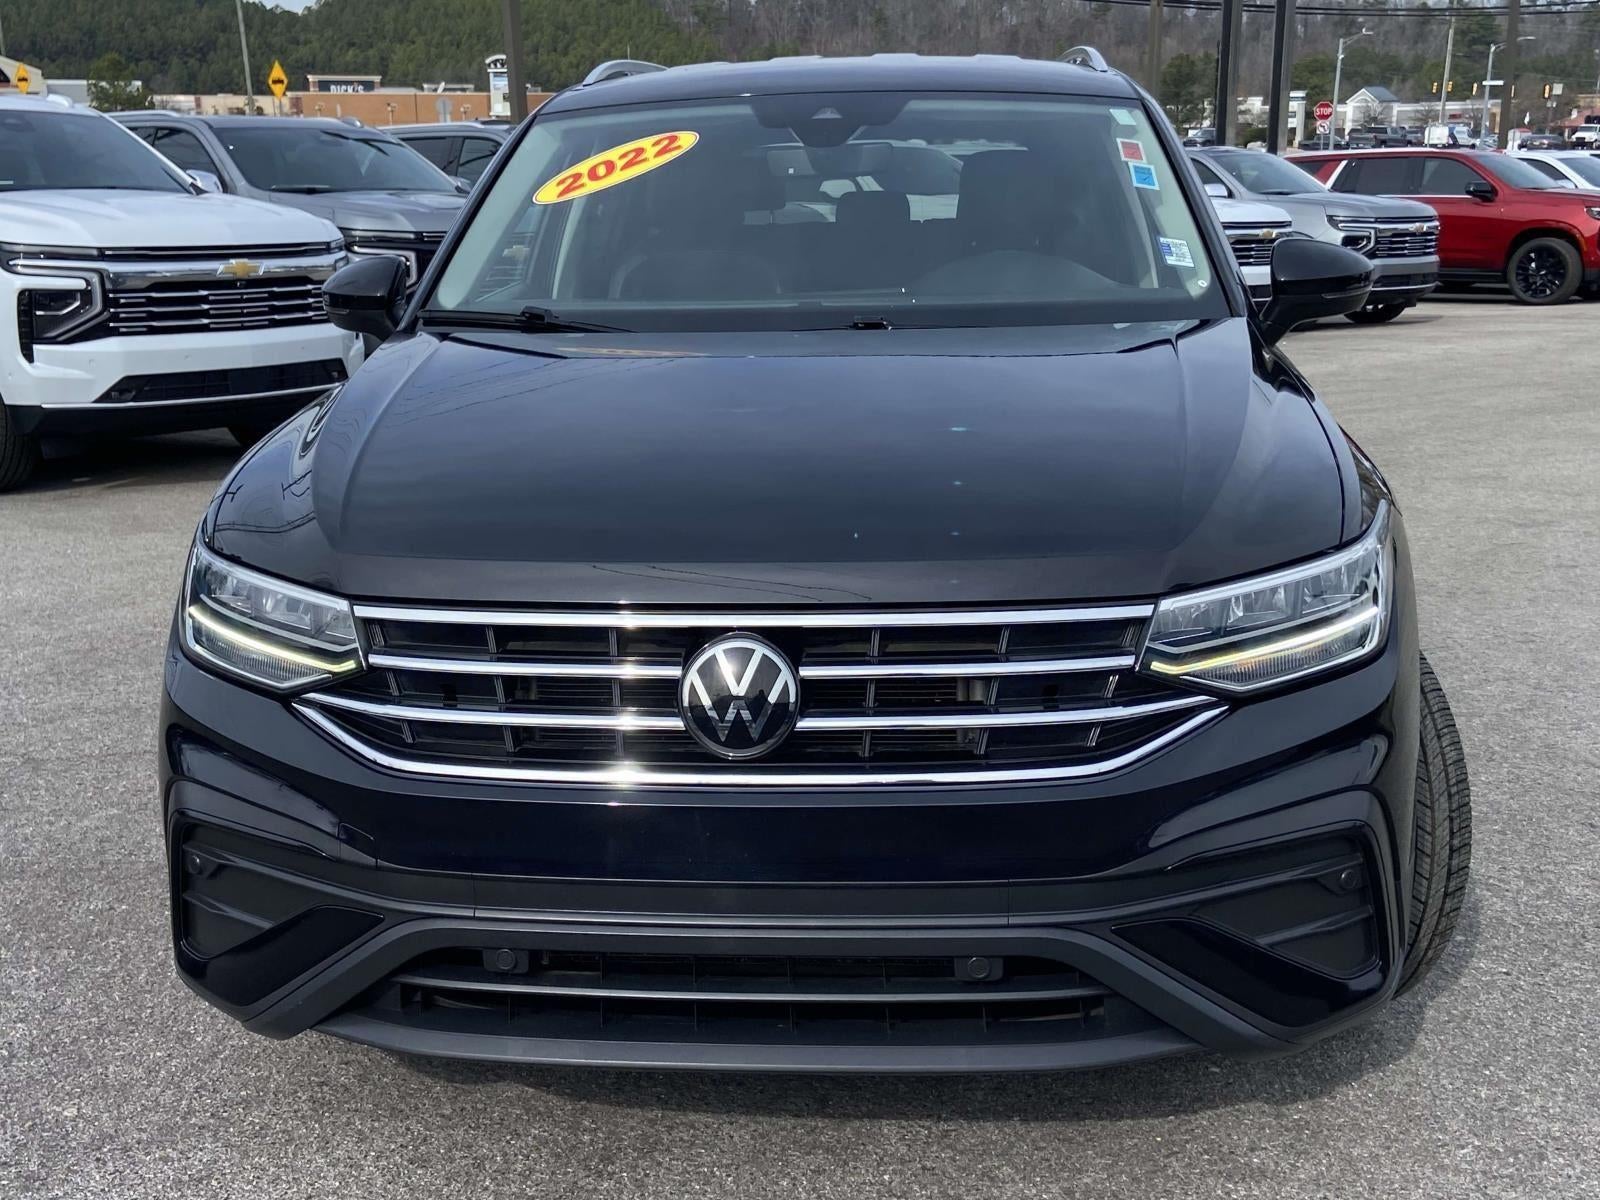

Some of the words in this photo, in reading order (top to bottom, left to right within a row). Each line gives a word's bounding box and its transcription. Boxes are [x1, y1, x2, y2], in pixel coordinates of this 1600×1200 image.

[1316, 107, 1333, 116] STOP
[556, 134, 682, 199] 2022
[690, 645, 789, 744] VW
